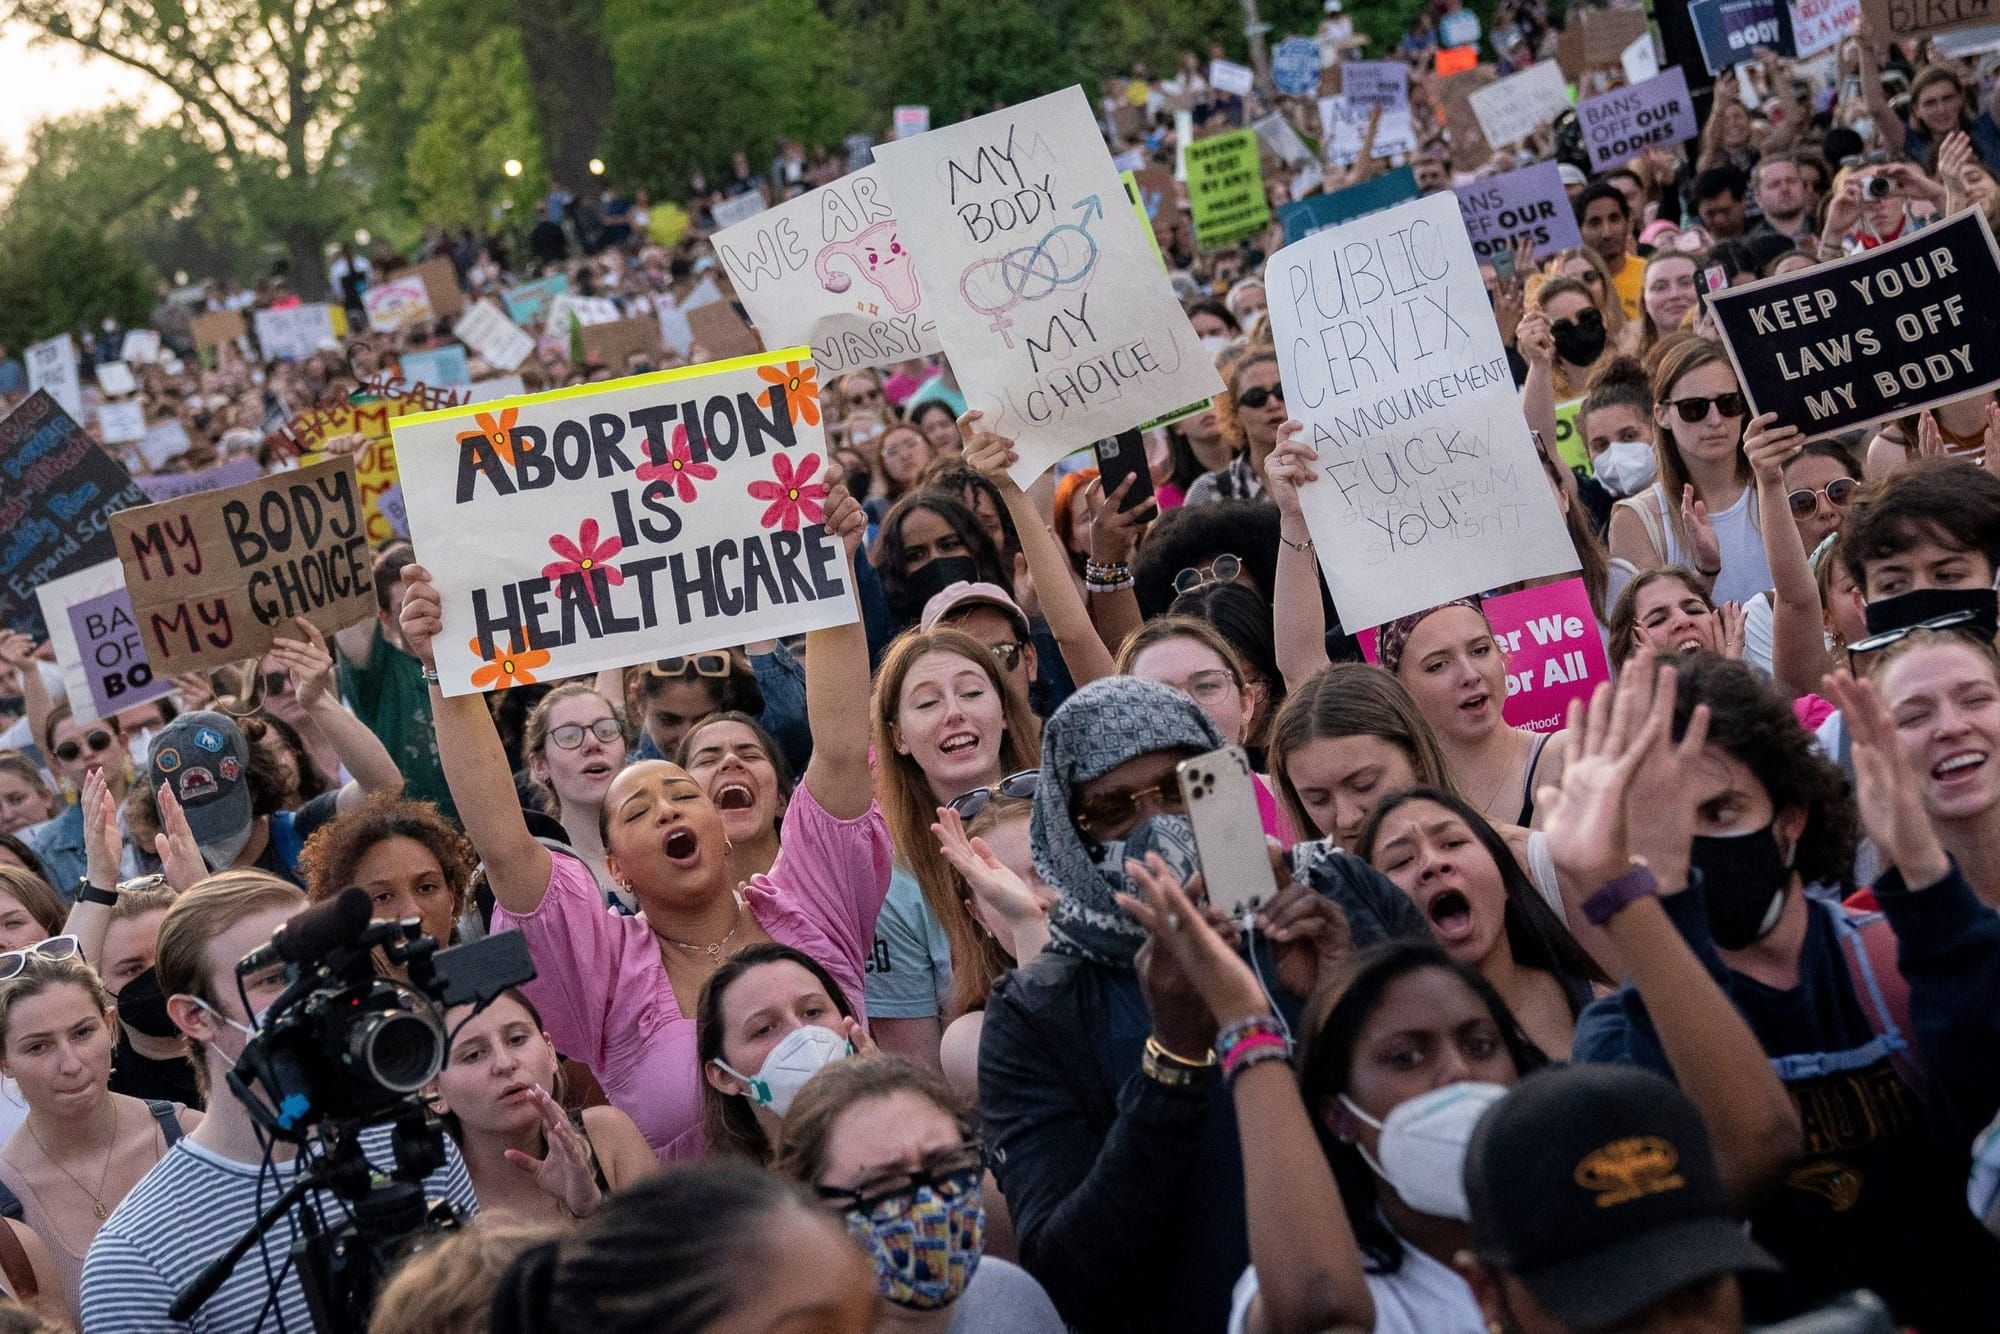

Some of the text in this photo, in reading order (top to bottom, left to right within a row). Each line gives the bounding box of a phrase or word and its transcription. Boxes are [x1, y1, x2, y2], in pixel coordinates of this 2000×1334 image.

[1728, 18, 1779, 50] BODY
[1586, 93, 1641, 124] BANS
[1592, 101, 1681, 142] OFF OUR
[1598, 122, 1674, 161] BODIES
[948, 124, 1025, 205] MY
[721, 217, 808, 292] WE
[821, 177, 893, 243] AR
[957, 174, 1056, 244] BODY
[1458, 188, 1504, 215] ANS
[1466, 200, 1557, 237] FF OUR
[1289, 219, 1450, 328] PUBLIC
[1474, 226, 1550, 256] ODIS
[1749, 247, 1959, 336] KEEP YOUR
[1026, 292, 1097, 373] MY
[1293, 286, 1470, 409] CERVIX
[1776, 294, 1965, 382] LAWS OFF
[366, 373, 473, 411] AGAIN
[1027, 341, 1160, 421] CHOICE
[1314, 358, 1507, 451] ANNOUNCEMENT:
[1803, 344, 1974, 421] MY BODY
[456, 383, 798, 504] ABORTION
[1325, 430, 1480, 505] FUCK
[130, 514, 203, 581] MY
[222, 471, 356, 568] BODY
[611, 480, 683, 548] IS
[8, 531, 81, 601] Expand
[152, 535, 372, 657] MY CHOICE
[471, 523, 846, 662] HEALTHCARE
[85, 605, 133, 640] BA
[95, 632, 140, 668] OF
[1495, 613, 1585, 655] er We
[103, 663, 153, 699] BO
[1505, 650, 1589, 697] or All
[1515, 713, 1560, 731] nthood
